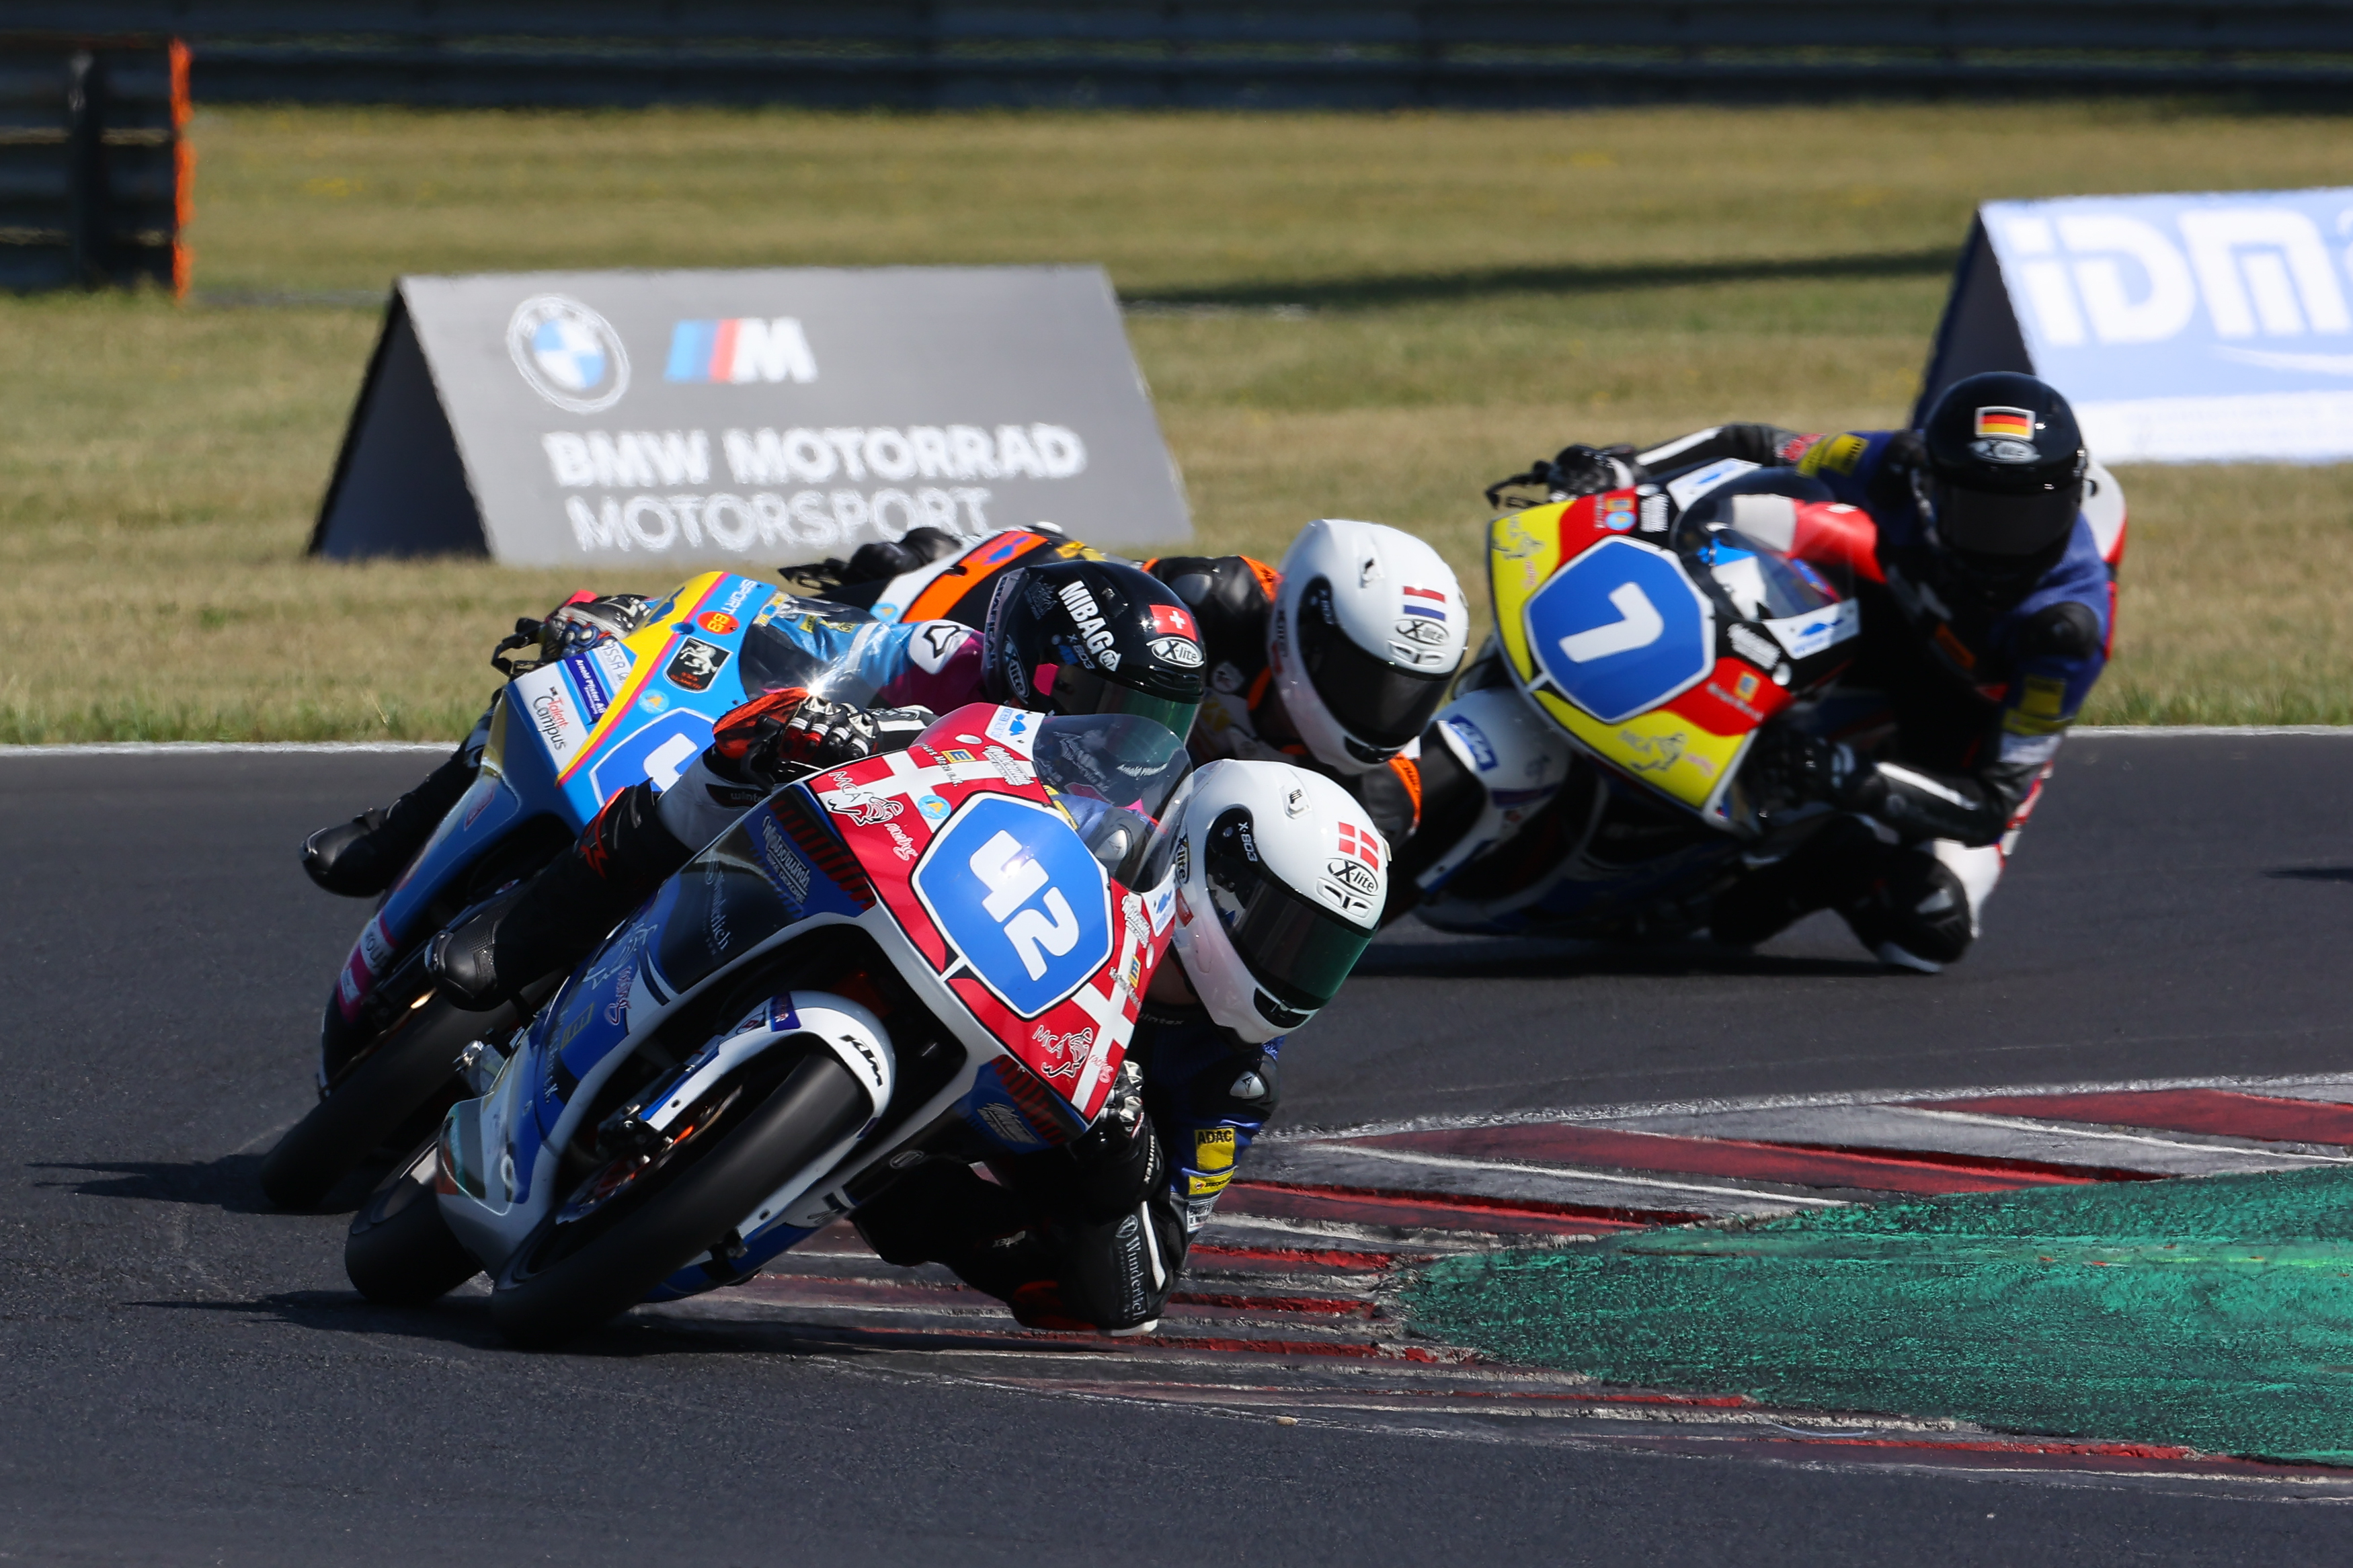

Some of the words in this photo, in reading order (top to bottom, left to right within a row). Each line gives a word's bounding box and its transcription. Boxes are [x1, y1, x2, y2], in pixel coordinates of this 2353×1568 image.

[733, 317, 817, 383] M
[542, 429, 709, 487] BMW
[723, 423, 1087, 485] MOTORRAD
[566, 487, 993, 552] MOTORSPORT
[721, 578, 758, 615] SPORT
[1058, 580, 1115, 655] MIBAG
[1163, 639, 1202, 665] X-lite
[533, 695, 567, 751] Campus
[547, 697, 569, 729] Talent
[828, 770, 861, 803] MCA
[1237, 821, 1259, 862] X-803
[1333, 860, 1375, 894] X-lite
[968, 829, 1080, 981] 42
[839, 1035, 883, 1087] KTM
[1033, 1025, 1064, 1059] MCA
[1197, 1130, 1233, 1145] ADAC
[1125, 1235, 1147, 1321] Wunderlich
